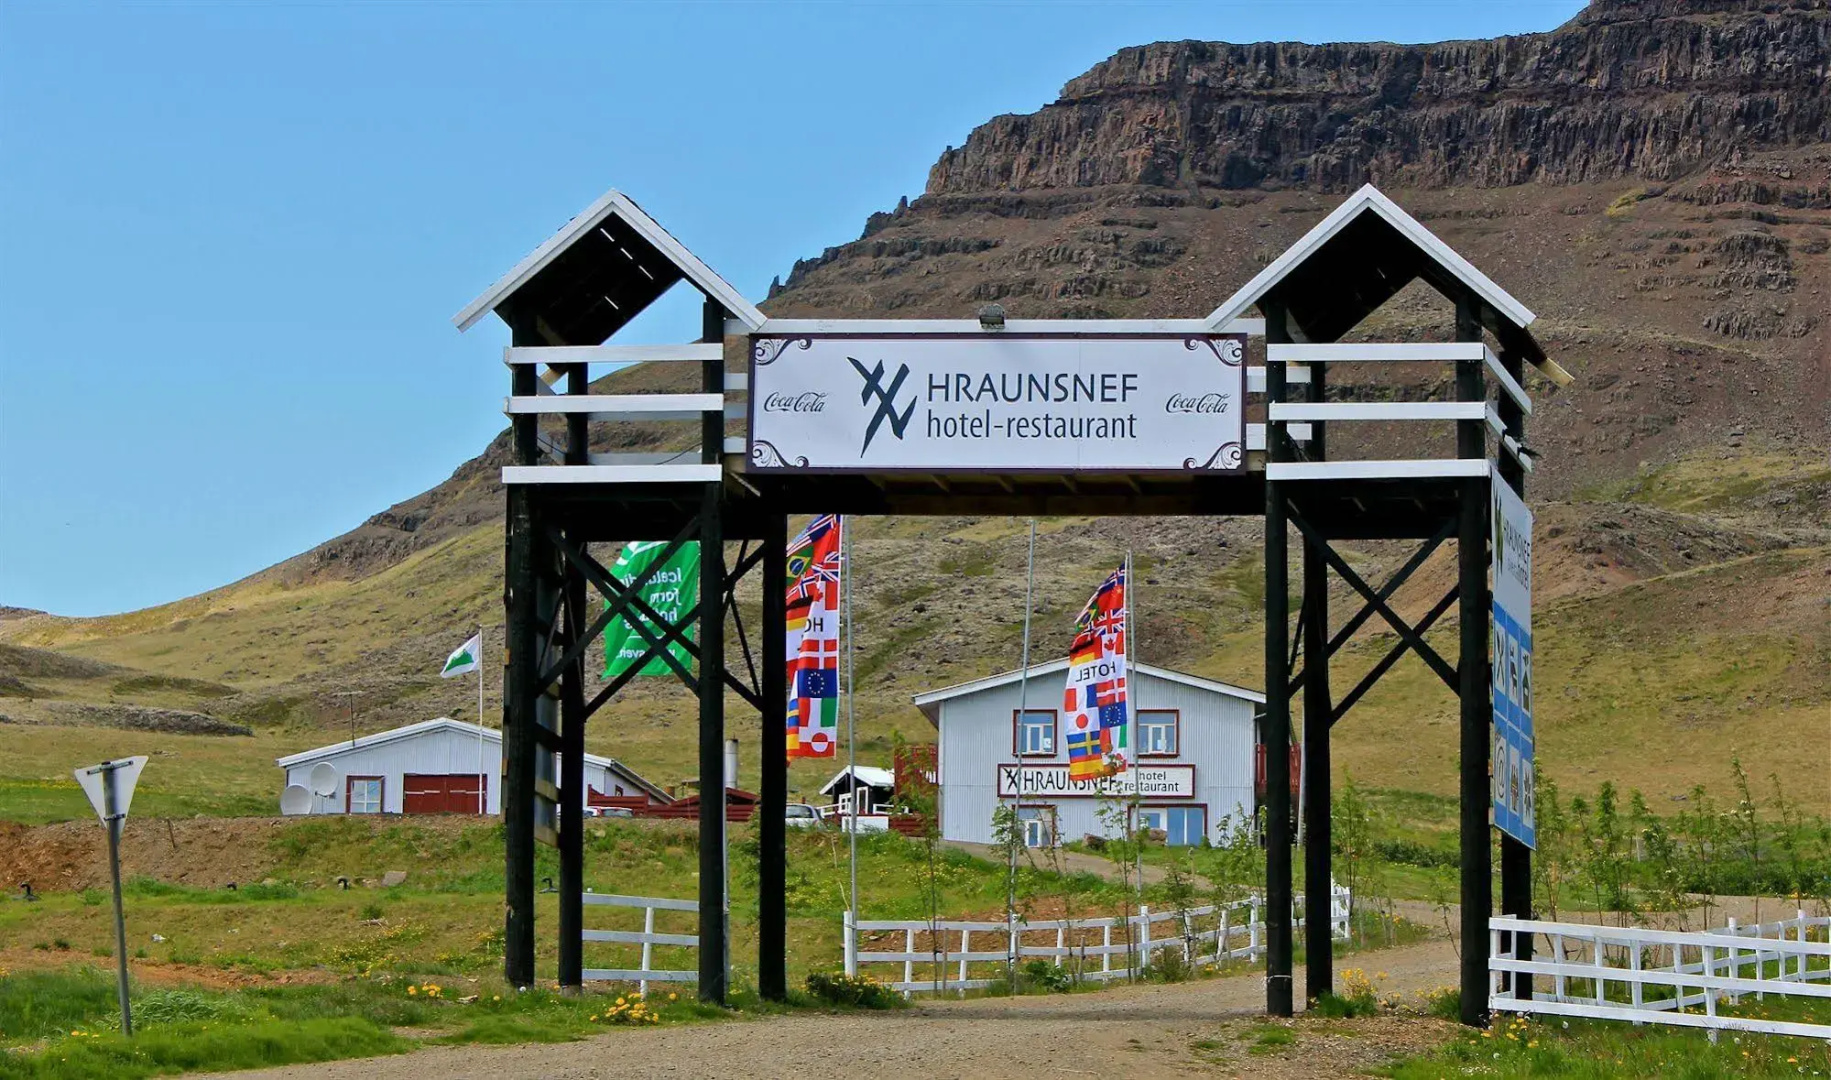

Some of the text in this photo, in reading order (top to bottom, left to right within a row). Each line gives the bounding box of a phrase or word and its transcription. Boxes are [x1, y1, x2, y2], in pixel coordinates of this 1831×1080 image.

[927, 373, 1139, 403] HRAUNSNEF
[763, 391, 828, 414] Coca-Cola
[1165, 392, 1230, 415] Coca-Cola
[926, 409, 1138, 440] hotel-restaurant
[1124, 781, 1180, 792] retaurant
[1137, 771, 1167, 781] hotel
